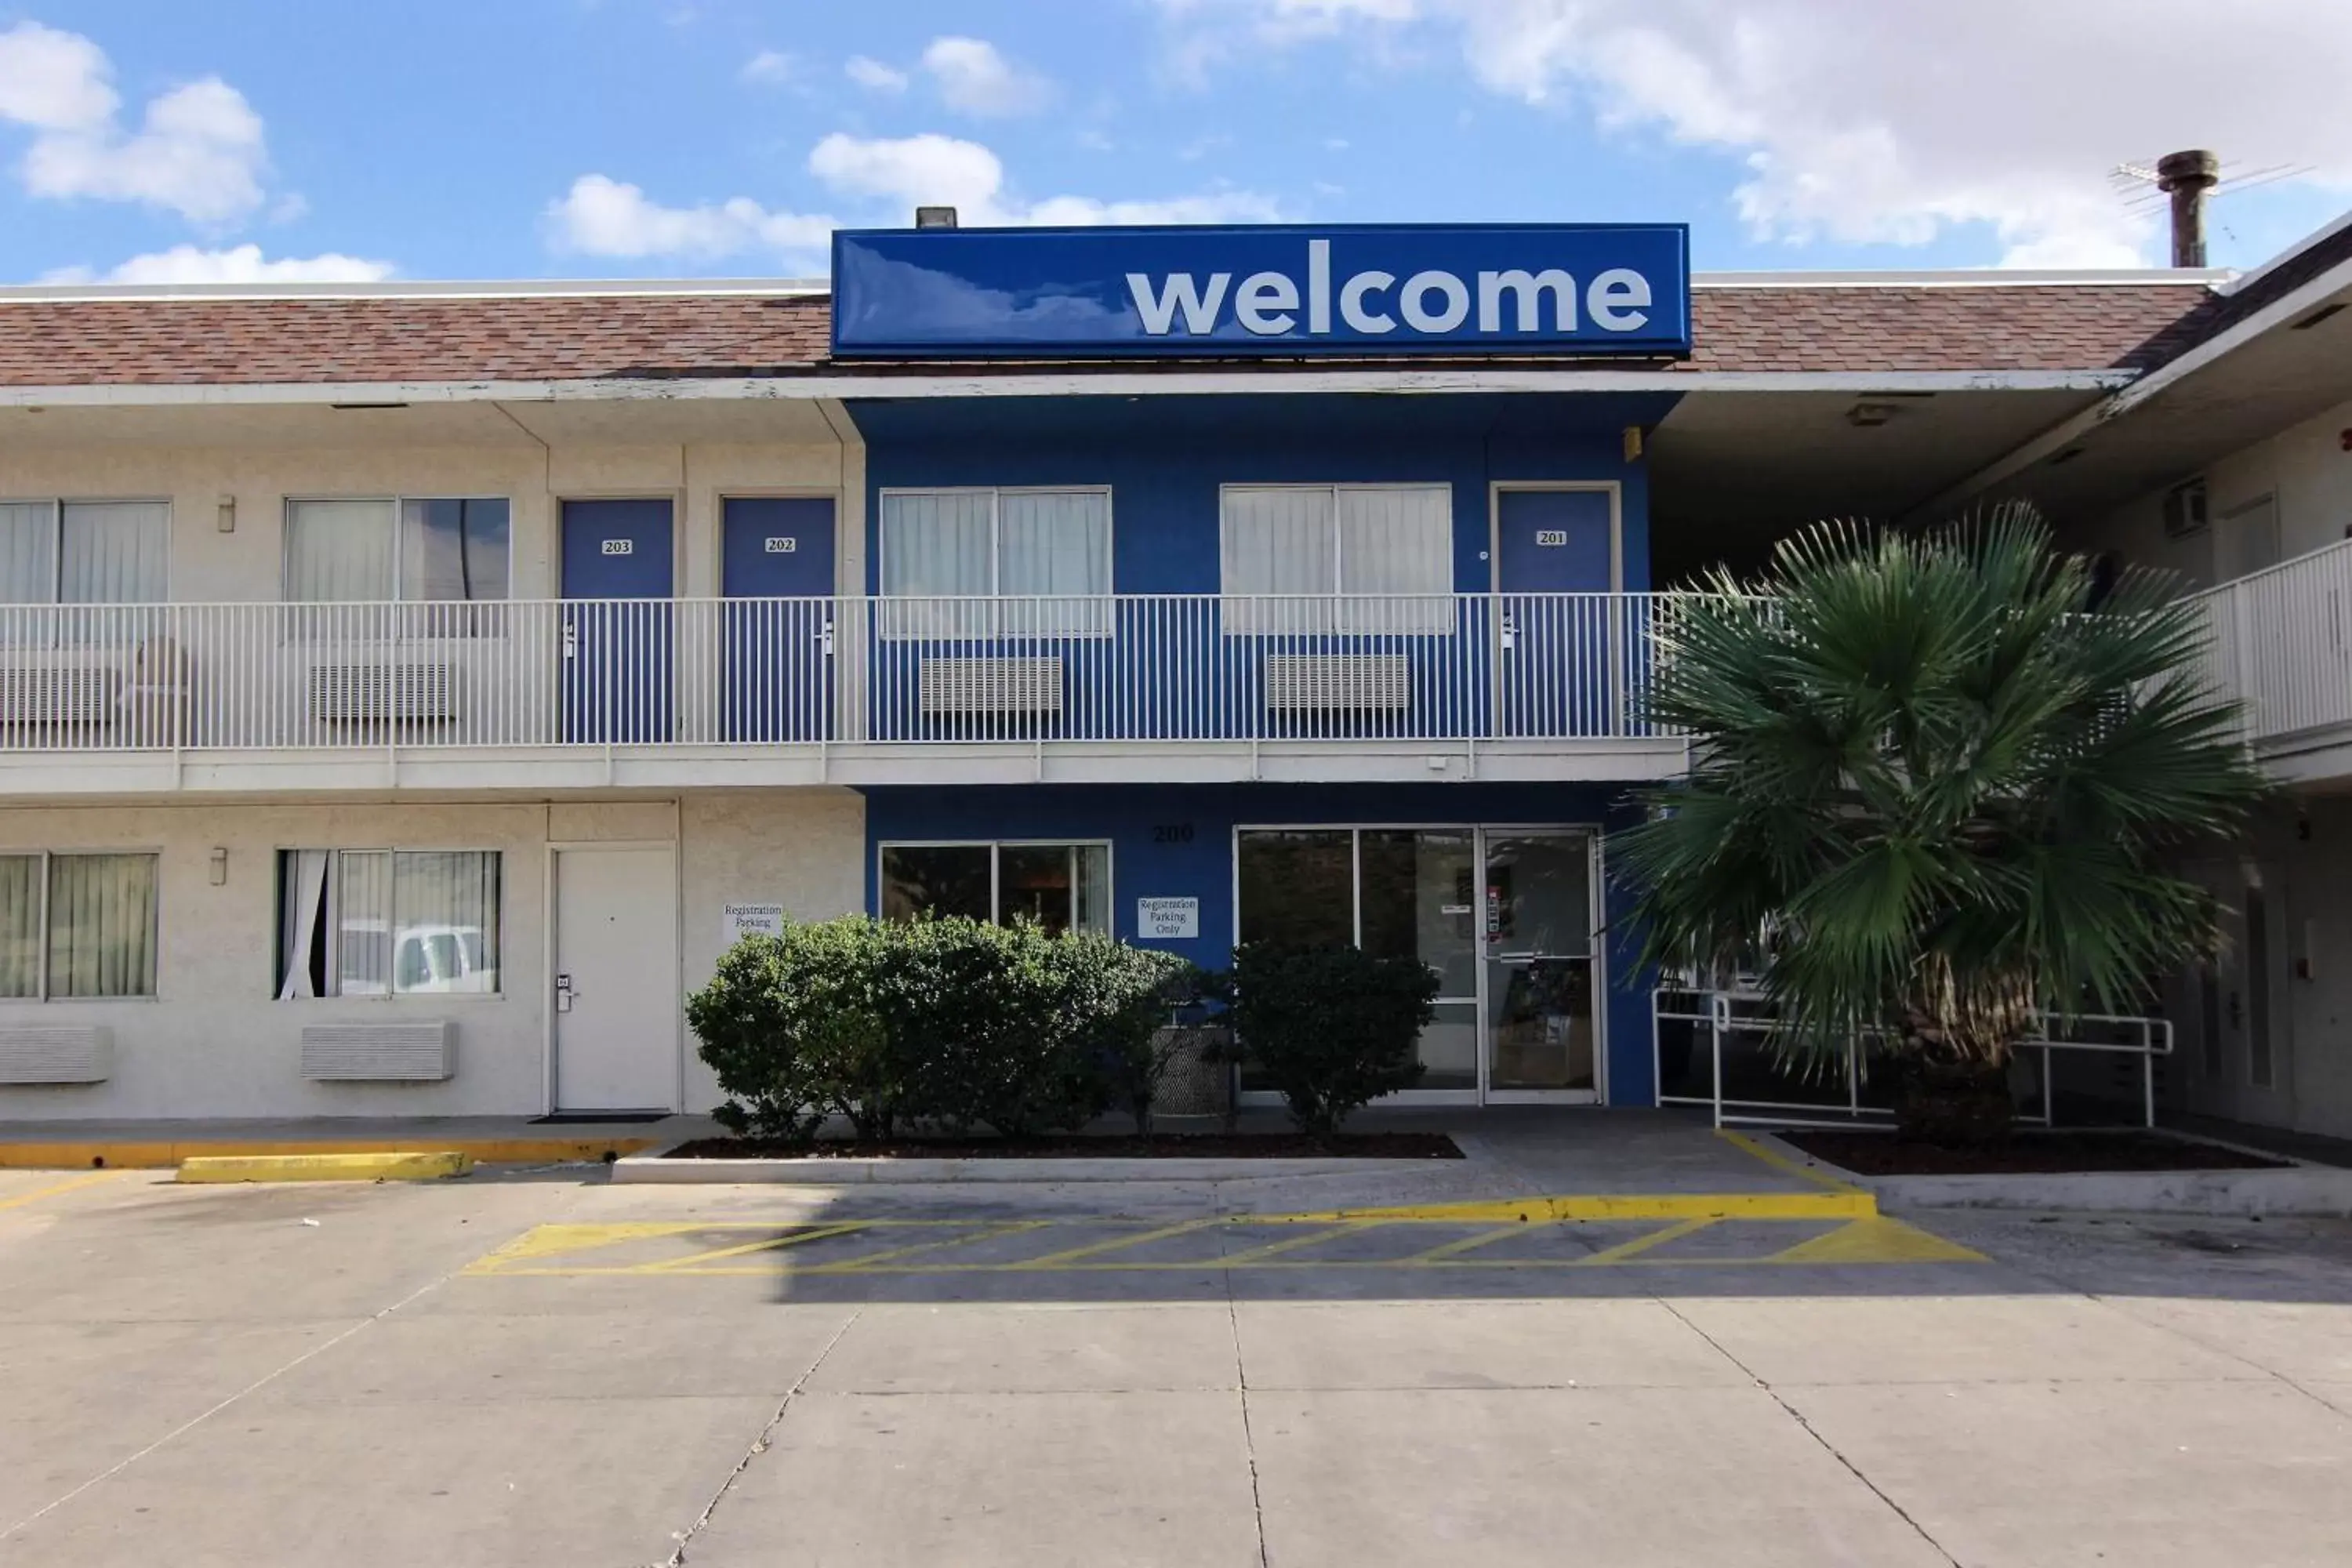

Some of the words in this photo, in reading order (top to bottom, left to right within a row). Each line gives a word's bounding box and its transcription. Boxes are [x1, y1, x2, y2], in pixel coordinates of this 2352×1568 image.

[1125, 239, 1652, 335] welcome
[1540, 532, 1563, 544] 201
[605, 541, 630, 554] 203
[768, 539, 793, 551] 202
[1152, 824, 1194, 844] 200
[725, 904, 782, 916] Registration
[1141, 899, 1196, 912] Registration
[735, 917, 771, 929] Parking
[1150, 912, 1187, 924] Parking
[1156, 924, 1181, 935] Only
